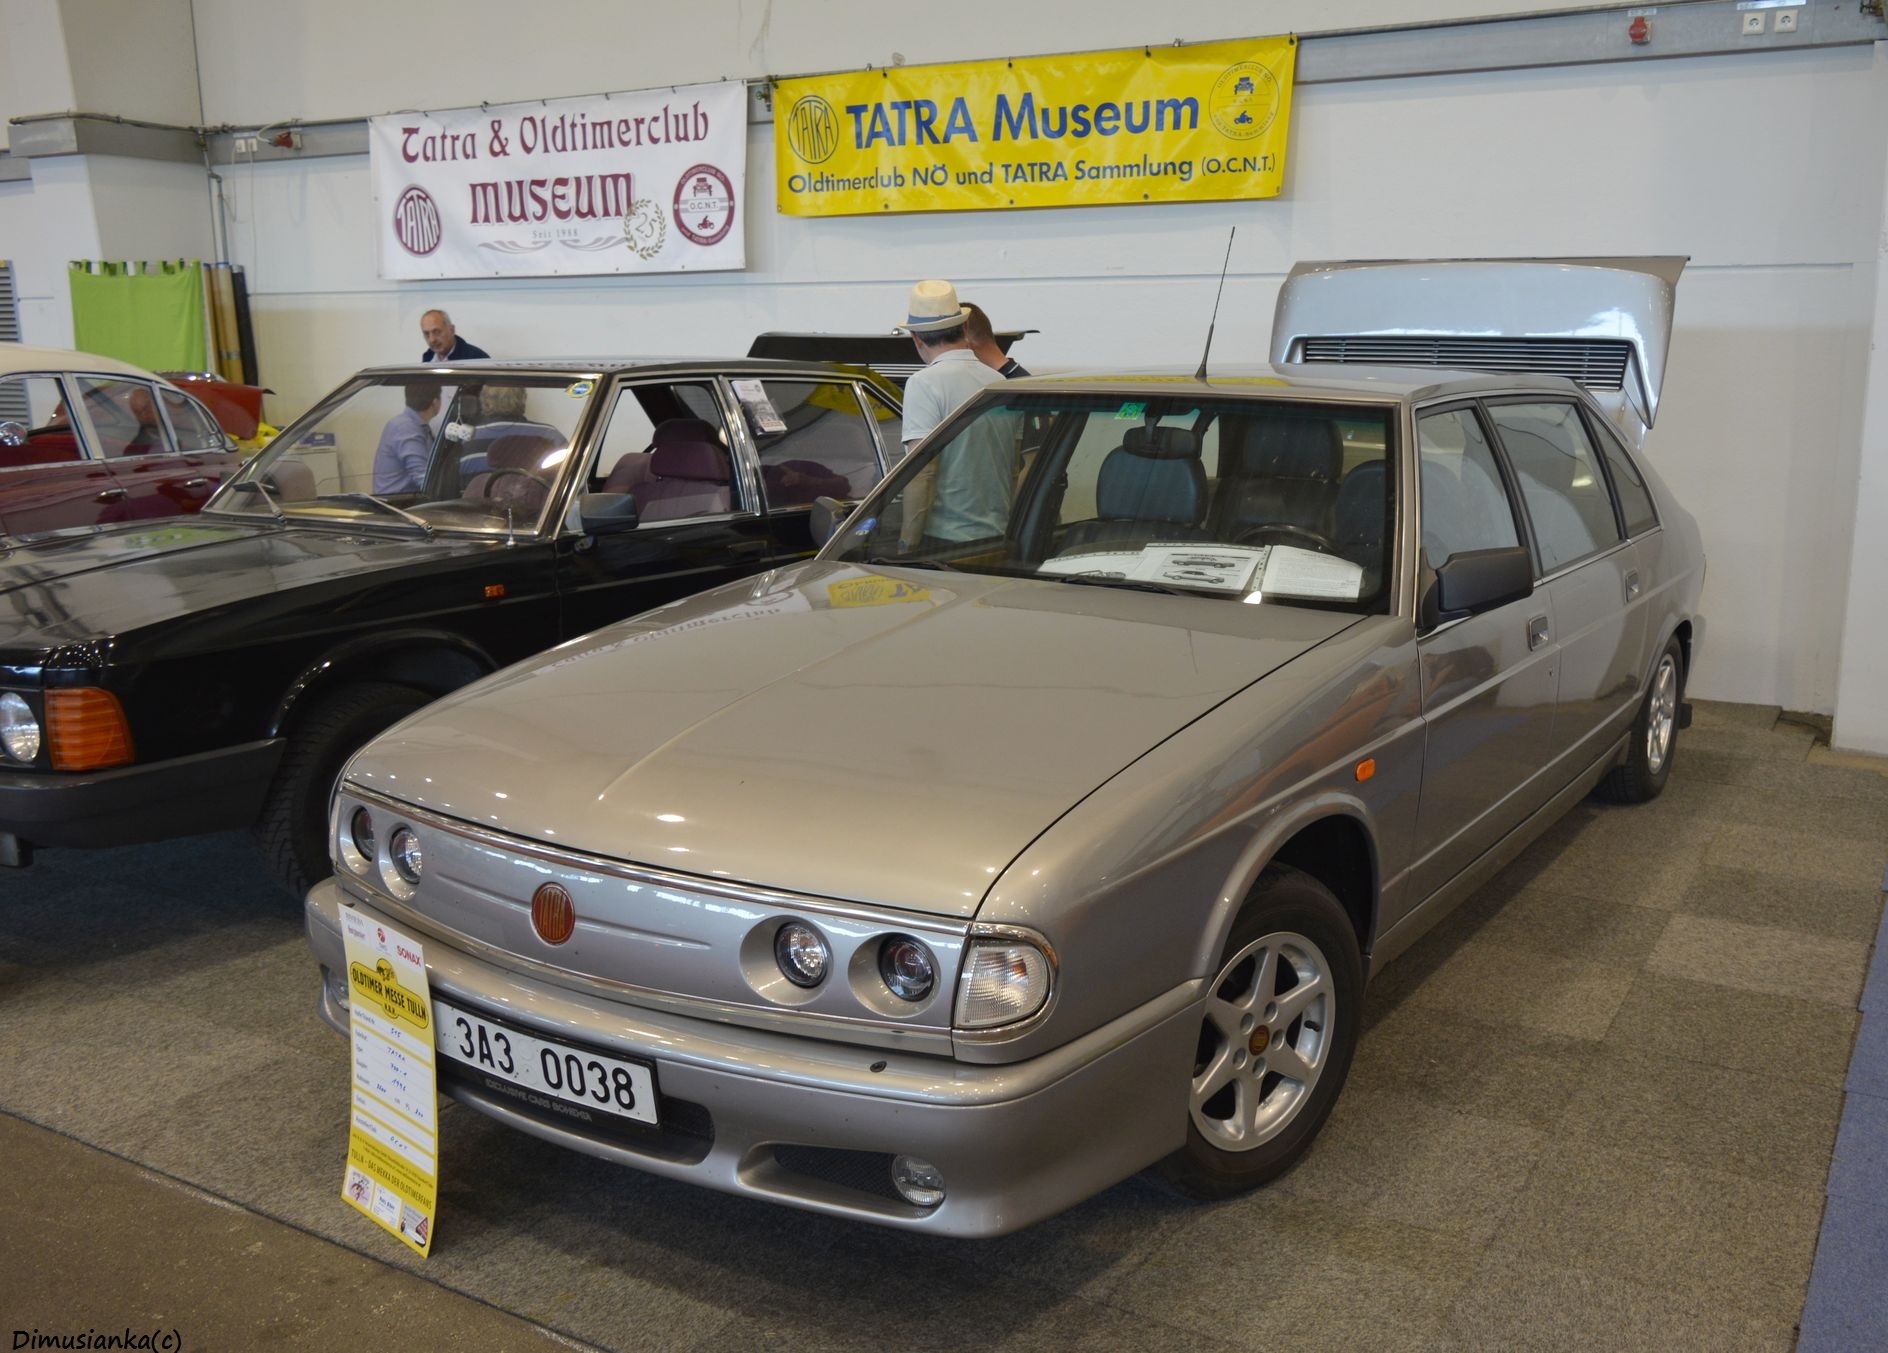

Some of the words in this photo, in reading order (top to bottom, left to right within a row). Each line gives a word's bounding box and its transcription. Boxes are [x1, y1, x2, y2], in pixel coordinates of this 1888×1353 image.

[401, 125, 478, 163] Tatra
[489, 119, 510, 157] &
[520, 100, 709, 155] Oldtimerclub
[846, 97, 980, 150] TATRA
[992, 92, 1200, 142] Museum
[788, 166, 905, 193] Oldtimerclub
[912, 163, 949, 186] NÖ
[956, 162, 994, 185] und
[1001, 161, 1068, 184] TATRA
[1074, 153, 1193, 182] Sammlung
[1201, 152, 1276, 177] (O.C.N.T.)
[352, 968, 383, 997] OLDTIMER
[385, 985, 405, 1009] MESSE
[407, 998, 426, 1021] TULLN
[456, 1017, 514, 1074] 3A3
[541, 1048, 635, 1110] 0038
